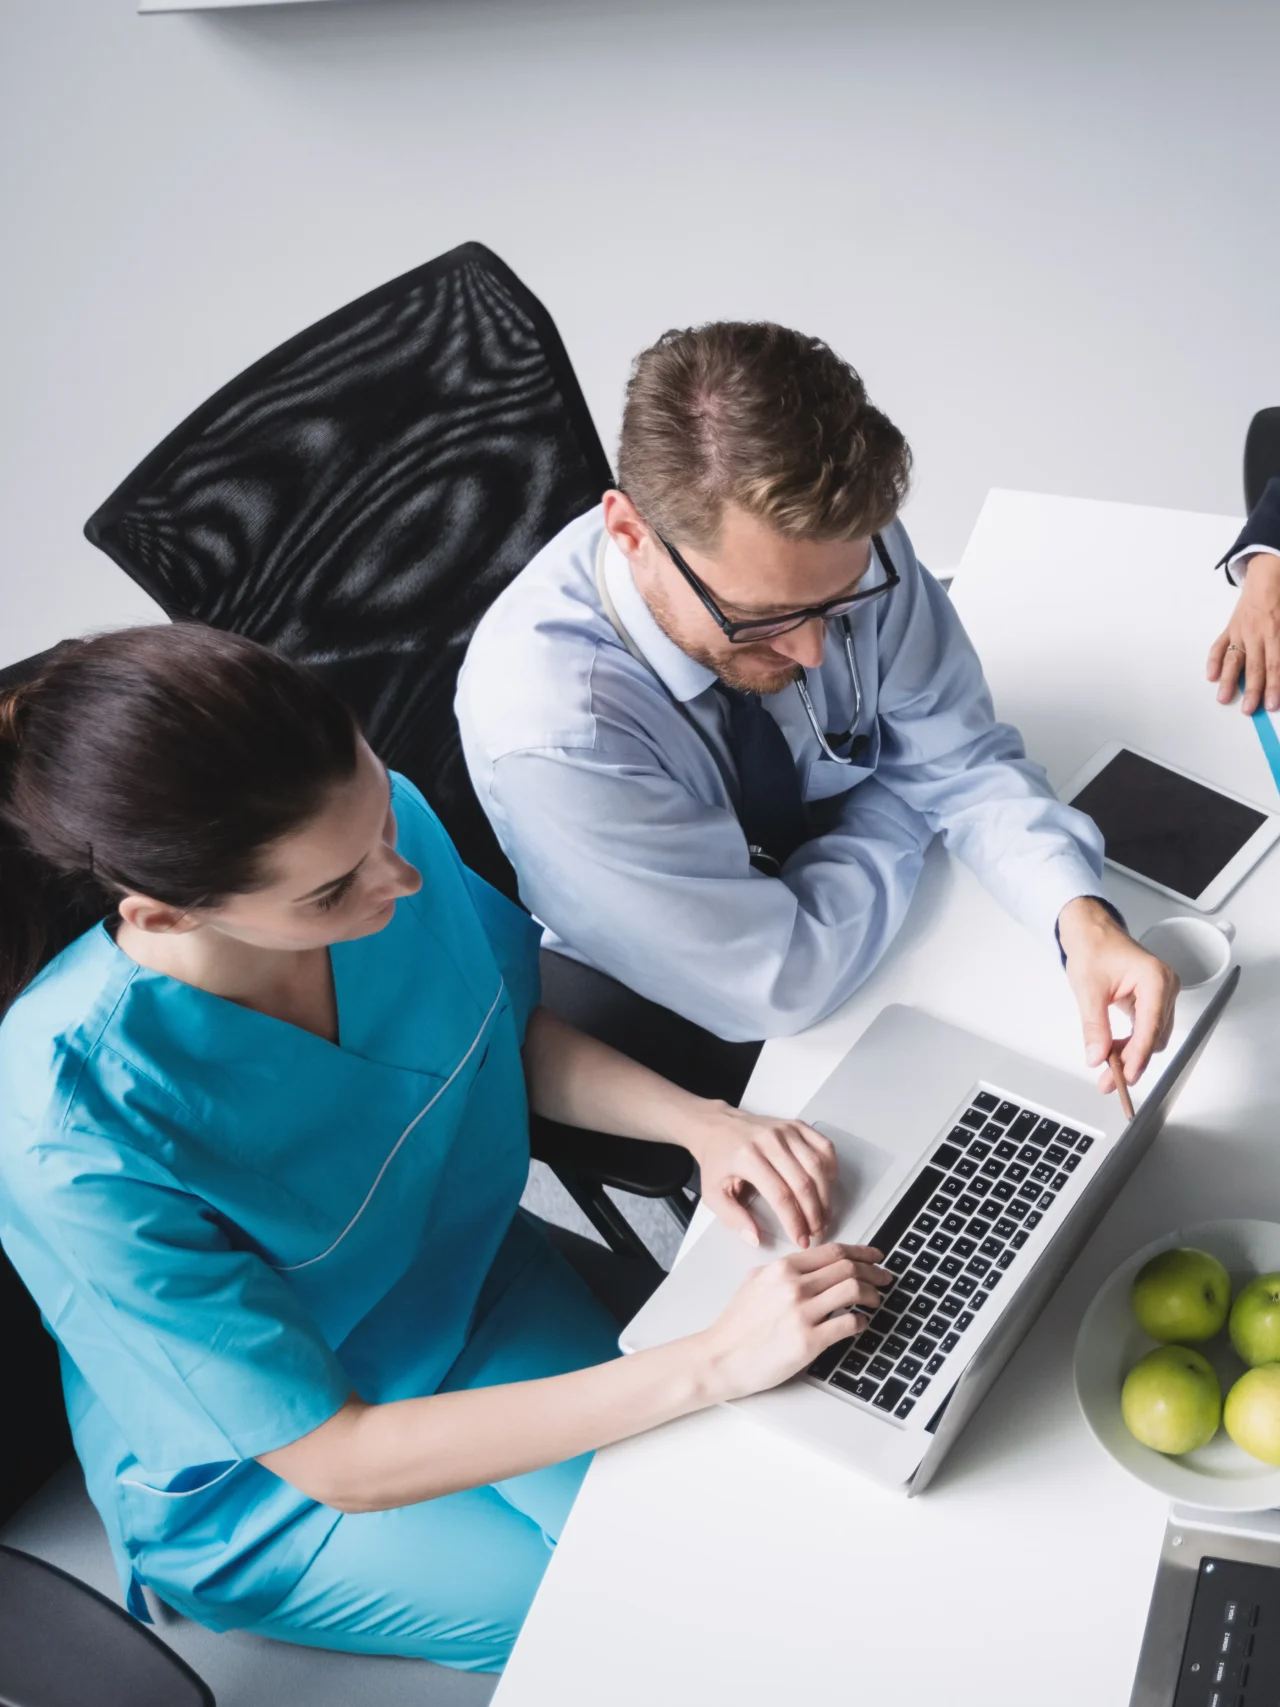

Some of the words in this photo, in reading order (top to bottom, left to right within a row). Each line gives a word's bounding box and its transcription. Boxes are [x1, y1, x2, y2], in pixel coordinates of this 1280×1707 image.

[908, 1238, 916, 1246] N
[935, 1238, 943, 1246] H
[1227, 1608, 1235, 1620] VGA
[1216, 1666, 1224, 1682] HDMI
